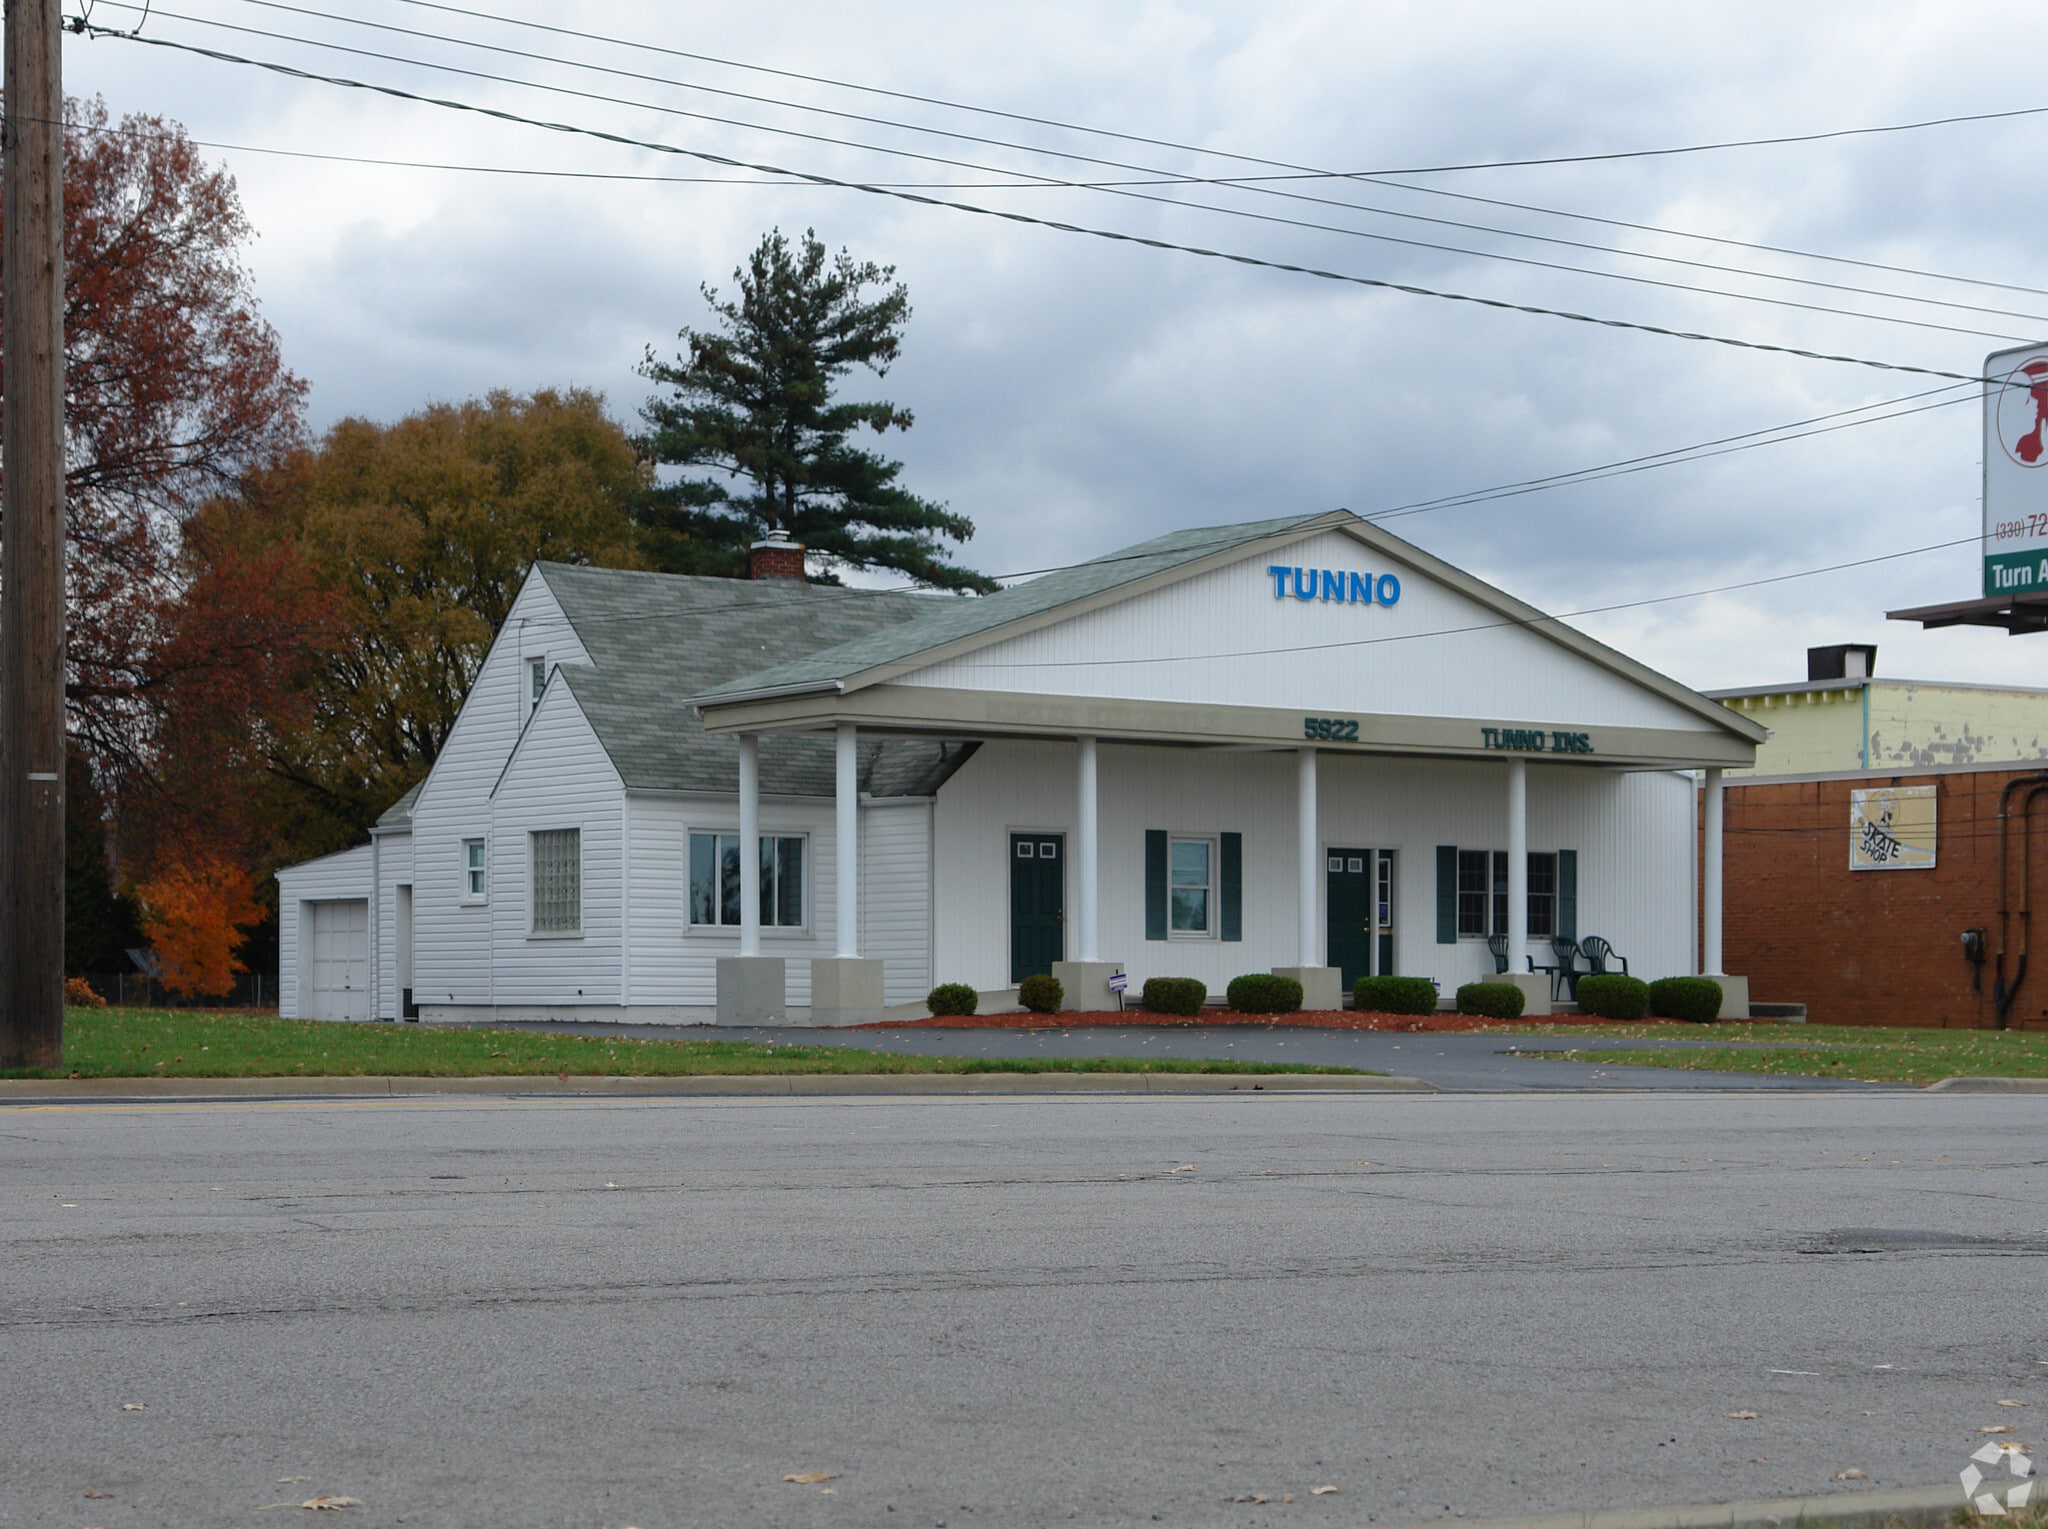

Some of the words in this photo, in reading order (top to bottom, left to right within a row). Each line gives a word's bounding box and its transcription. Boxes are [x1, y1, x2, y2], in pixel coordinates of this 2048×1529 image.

[1996, 518, 2025, 540] (330)
[1268, 565, 1401, 608] TUNNO
[1992, 564, 2032, 588] Turn
[1304, 717, 1359, 740] 5922
[1481, 727, 1545, 751] TUNNO
[1552, 731, 1595, 753] INS.
[1860, 840, 1888, 863] SHOP
[1862, 821, 1902, 859] SKATE
